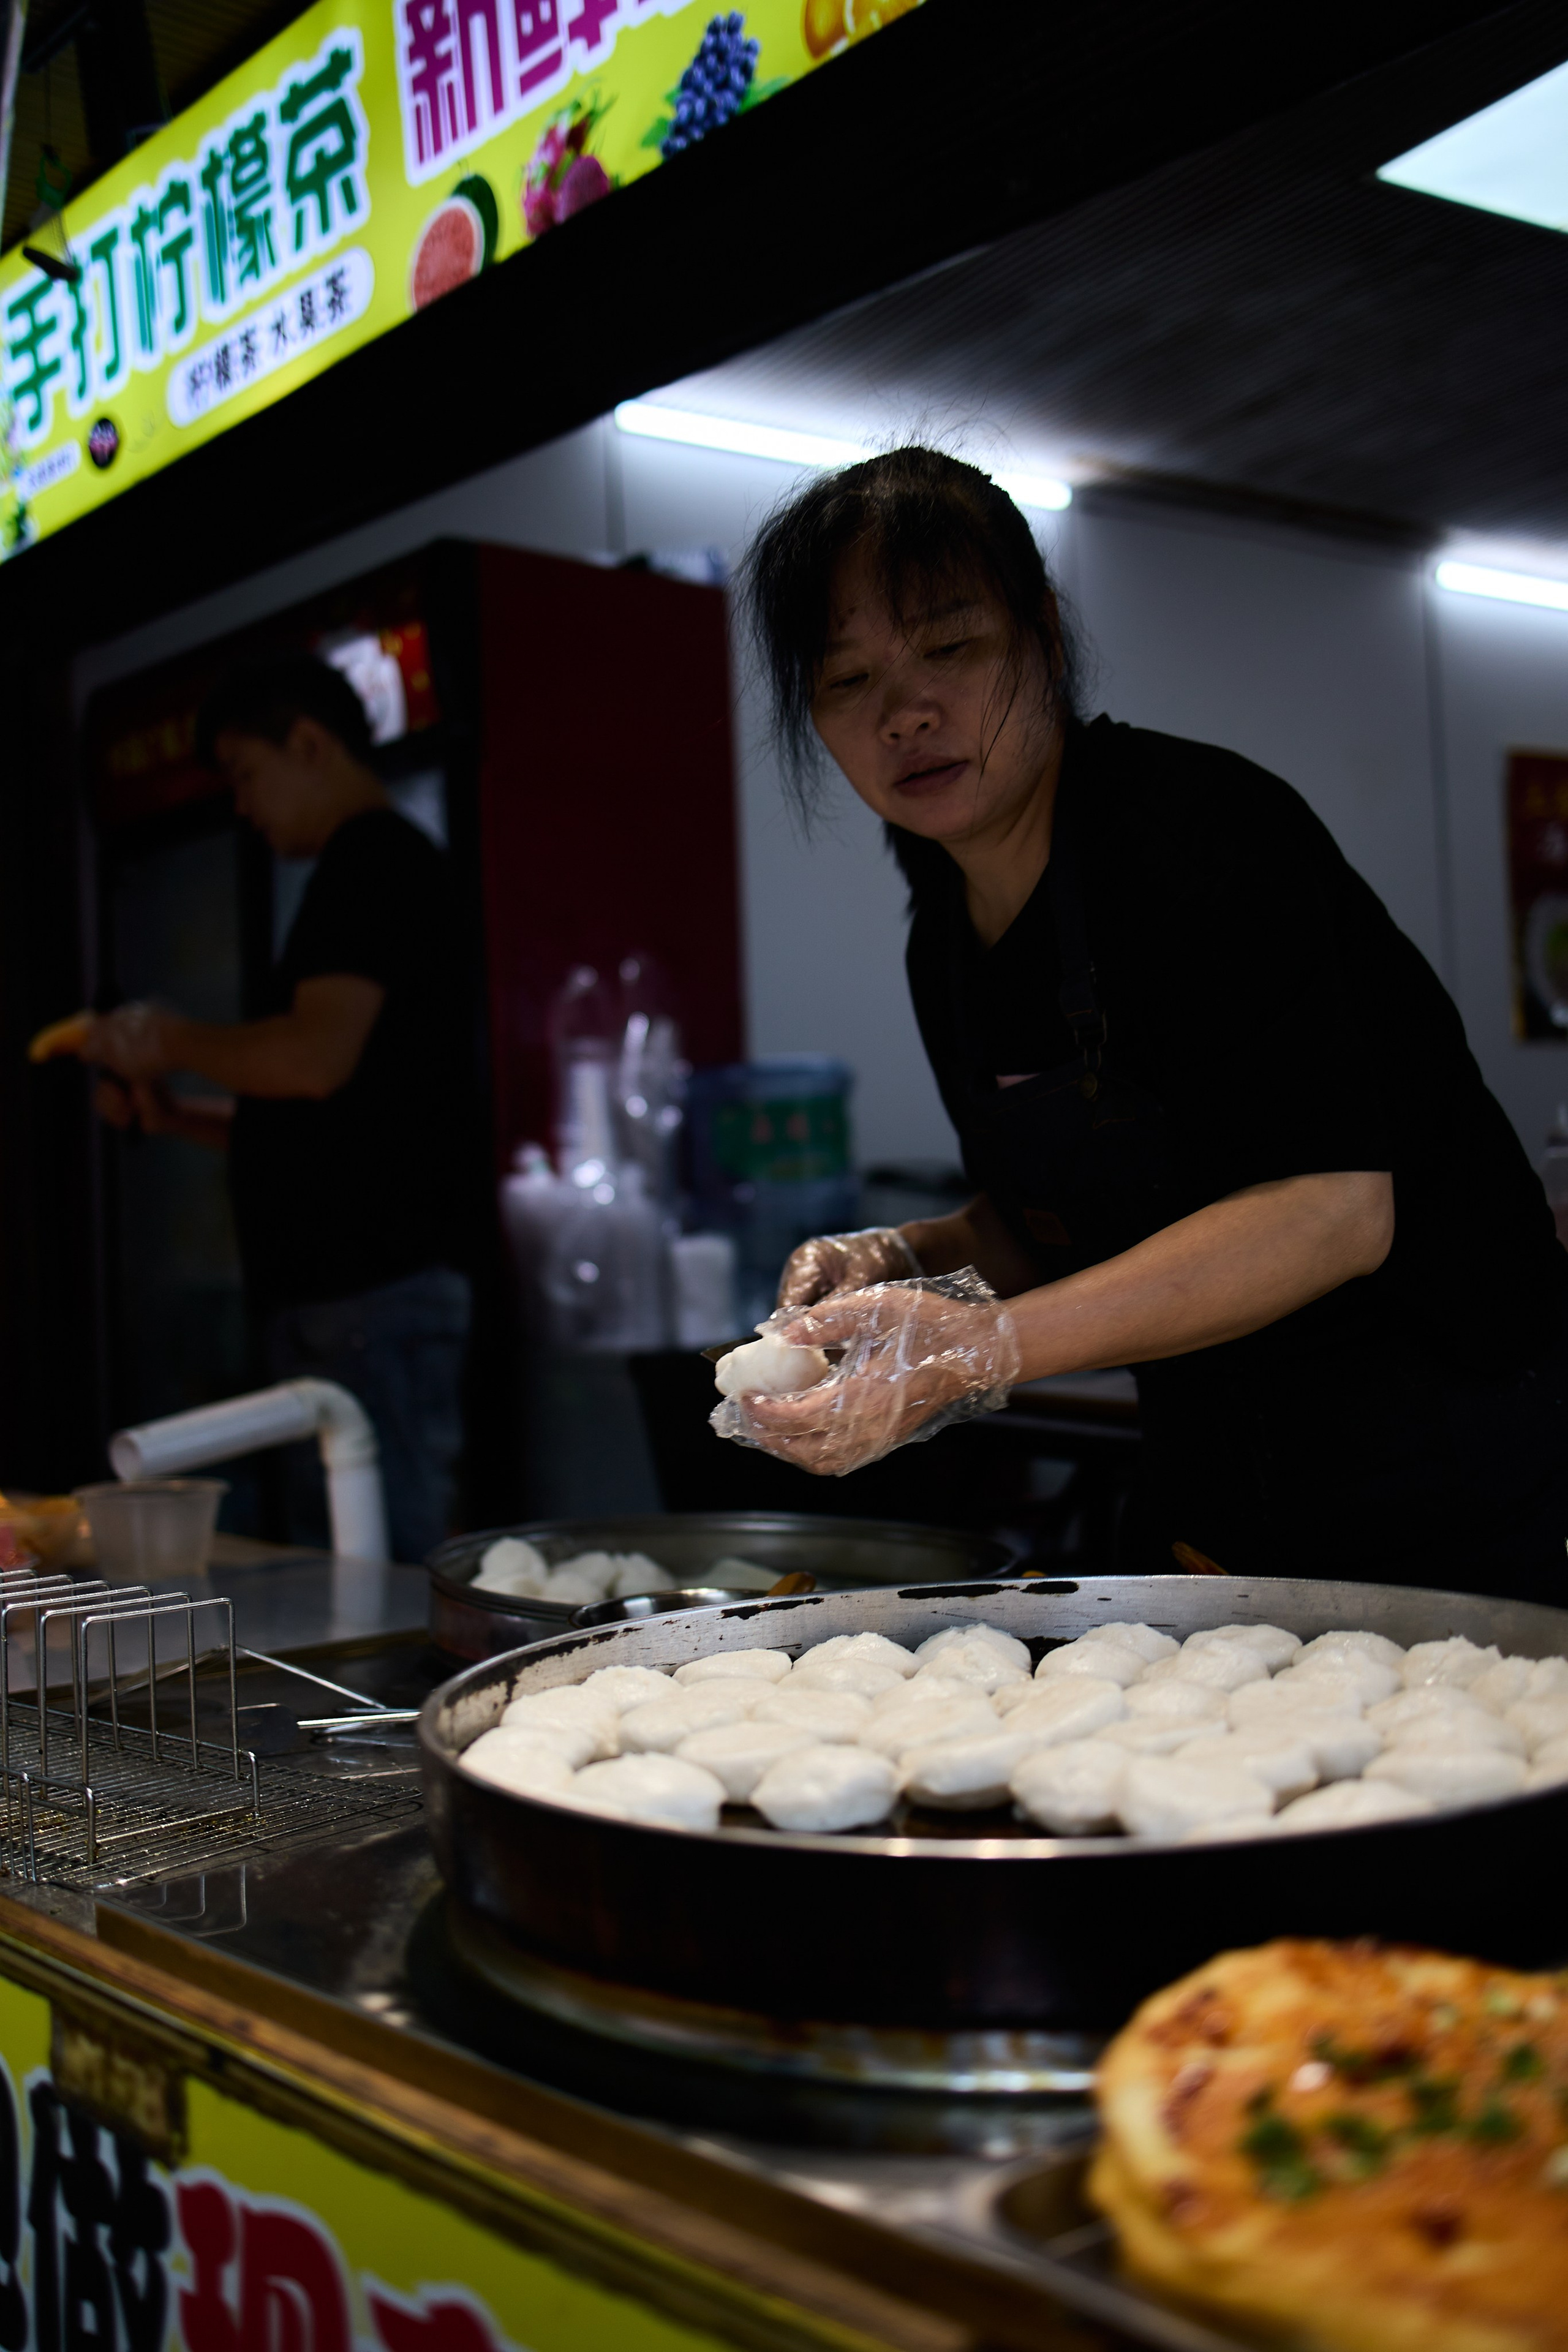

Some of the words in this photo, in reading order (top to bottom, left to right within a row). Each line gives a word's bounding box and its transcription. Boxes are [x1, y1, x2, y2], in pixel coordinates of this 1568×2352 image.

[7, 46, 357, 431] 手打柠檬茶
[271, 265, 349, 355] 水果茶
